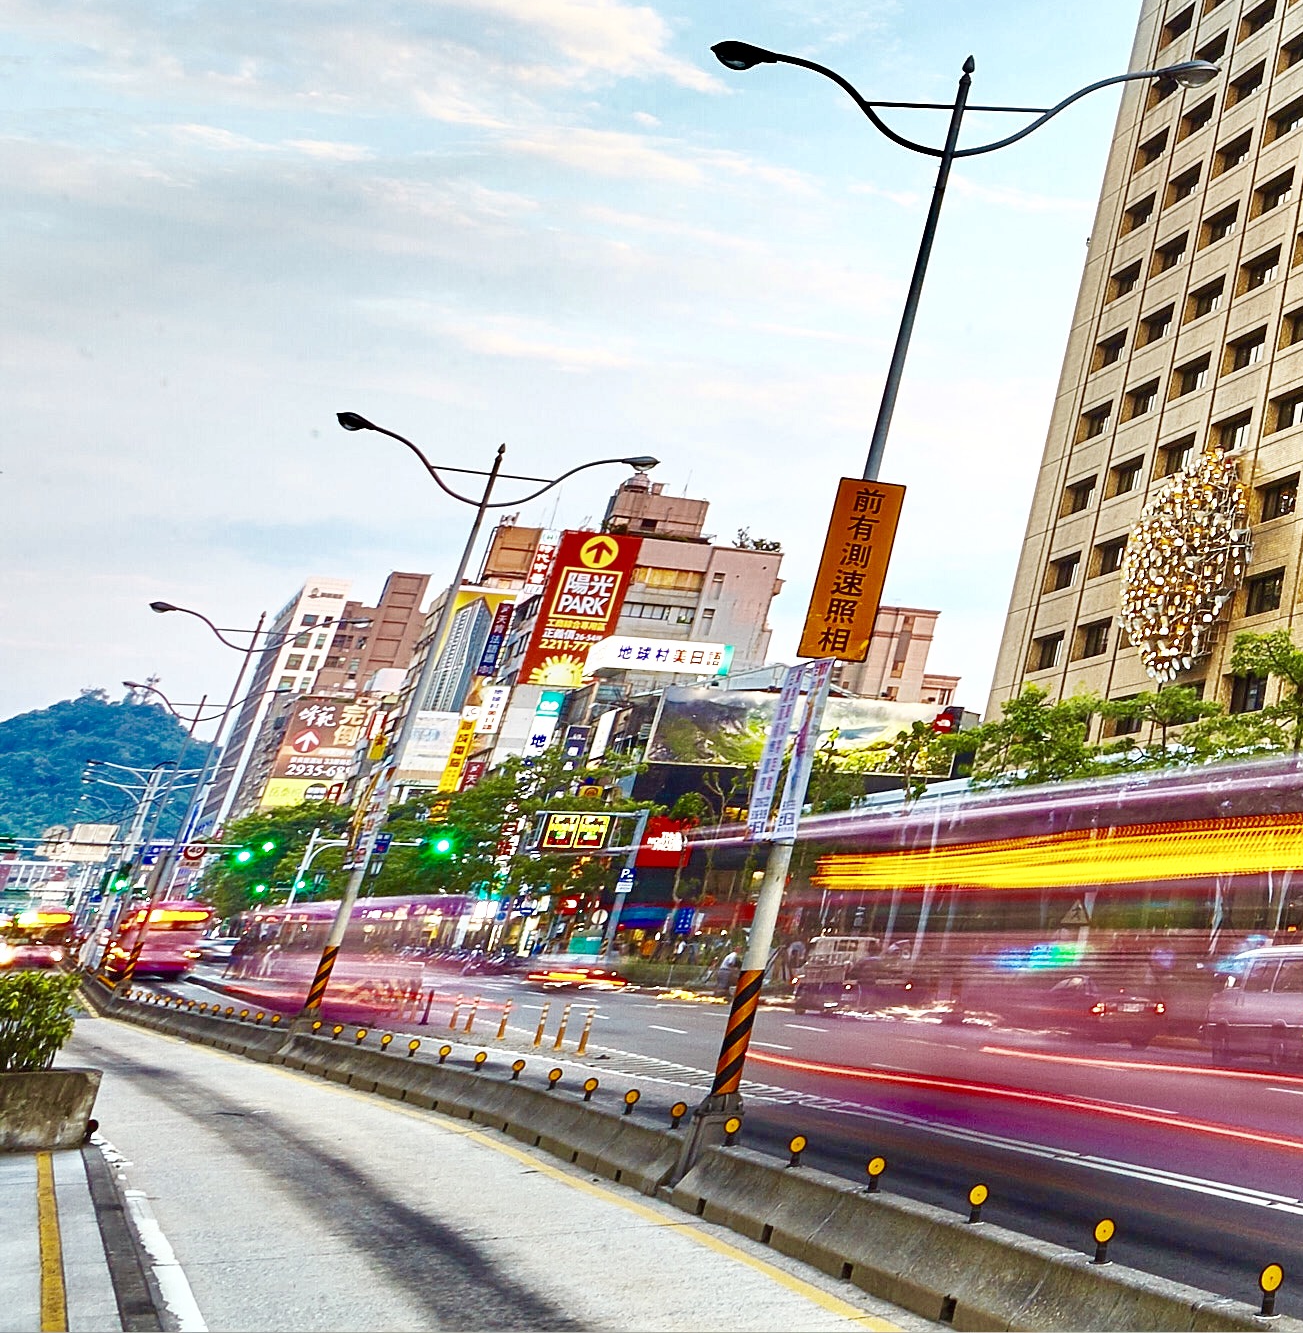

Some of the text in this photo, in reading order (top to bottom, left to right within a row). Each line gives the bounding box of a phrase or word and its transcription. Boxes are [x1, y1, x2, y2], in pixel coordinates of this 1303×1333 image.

[818, 487, 885, 653] 前有測速照相
[563, 571, 614, 597] 陽光
[557, 595, 608, 616] PARK
[540, 639, 595, 652] 2211-77
[618, 645, 722, 666] 地球村美日語
